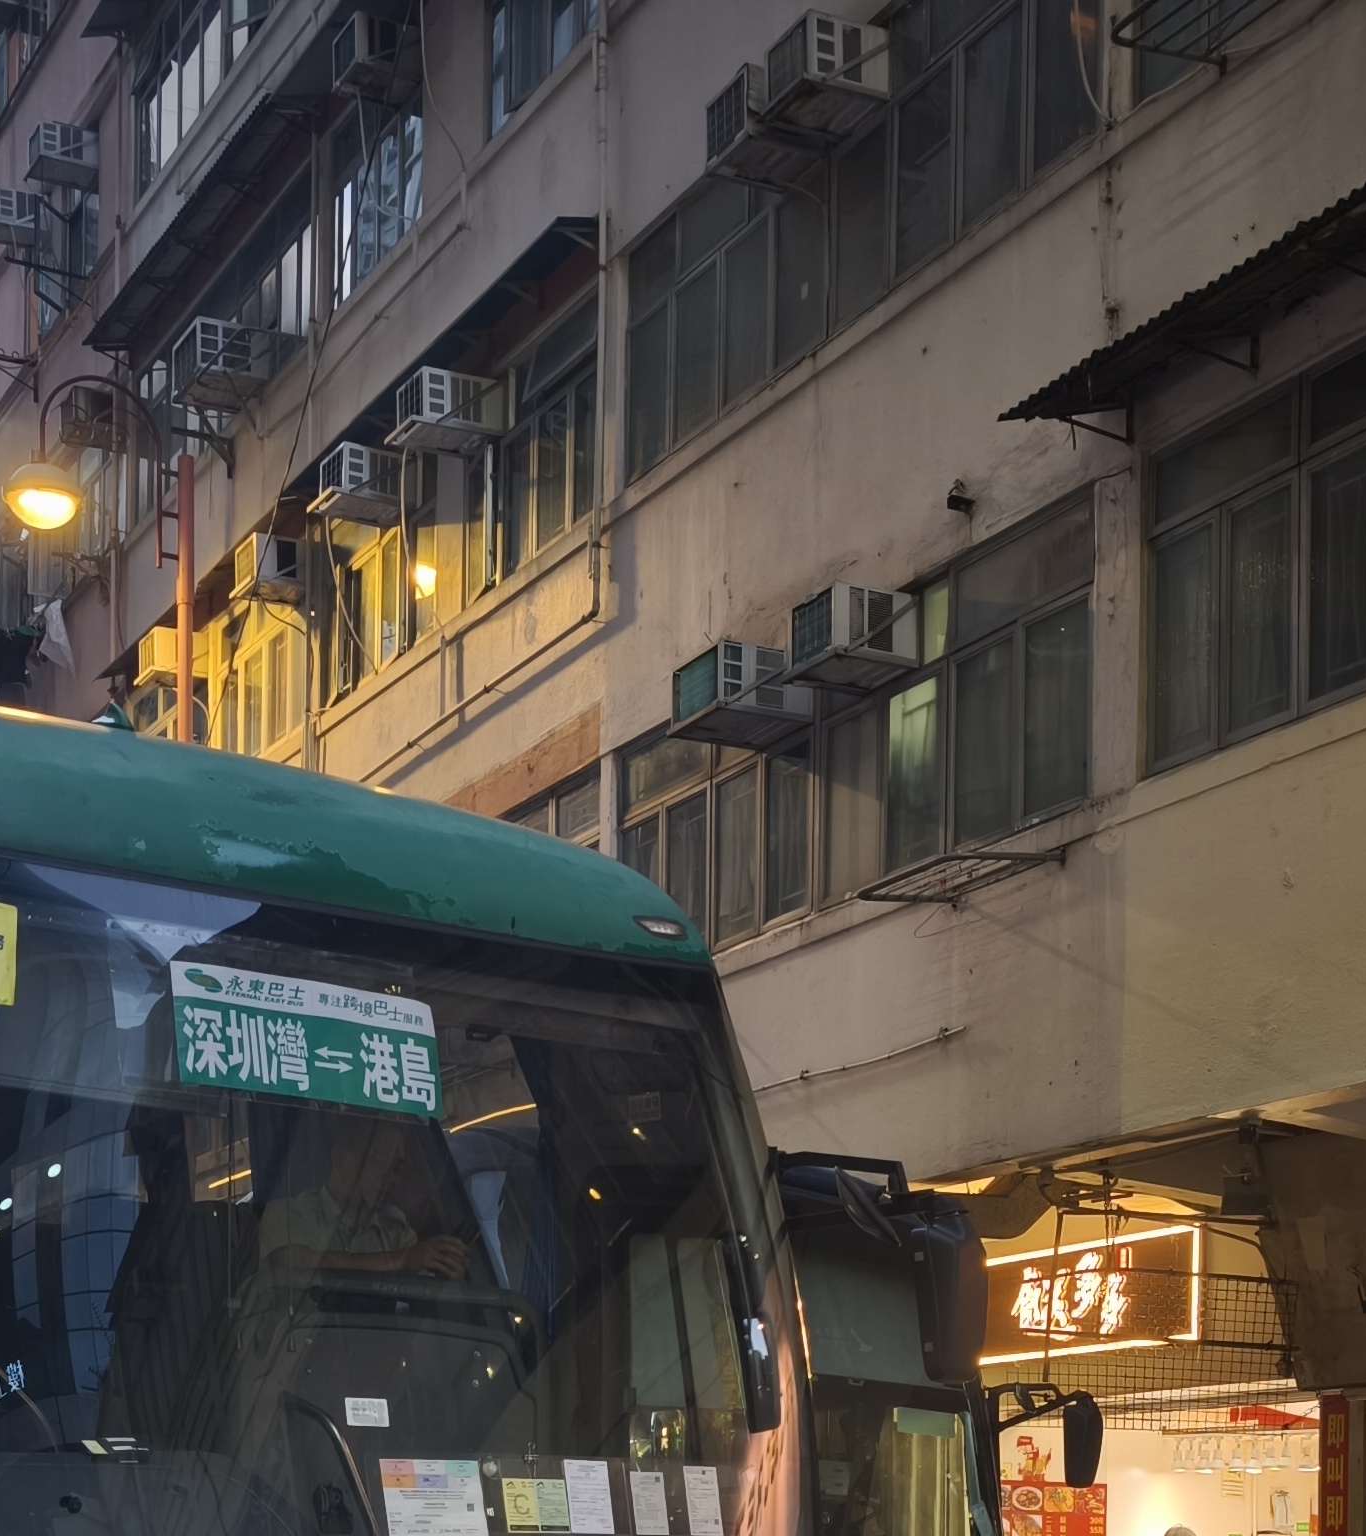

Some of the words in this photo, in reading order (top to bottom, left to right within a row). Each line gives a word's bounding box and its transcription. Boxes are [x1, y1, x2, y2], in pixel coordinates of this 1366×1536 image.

[225, 990, 262, 1002] ETERNAL
[263, 996, 286, 1006] EAST
[227, 975, 305, 1000] 永東巴士
[318, 993, 424, 1027] 專注跨境巴士服務
[182, 1004, 310, 1092] 深圳灣
[360, 1032, 436, 1111] 港島
